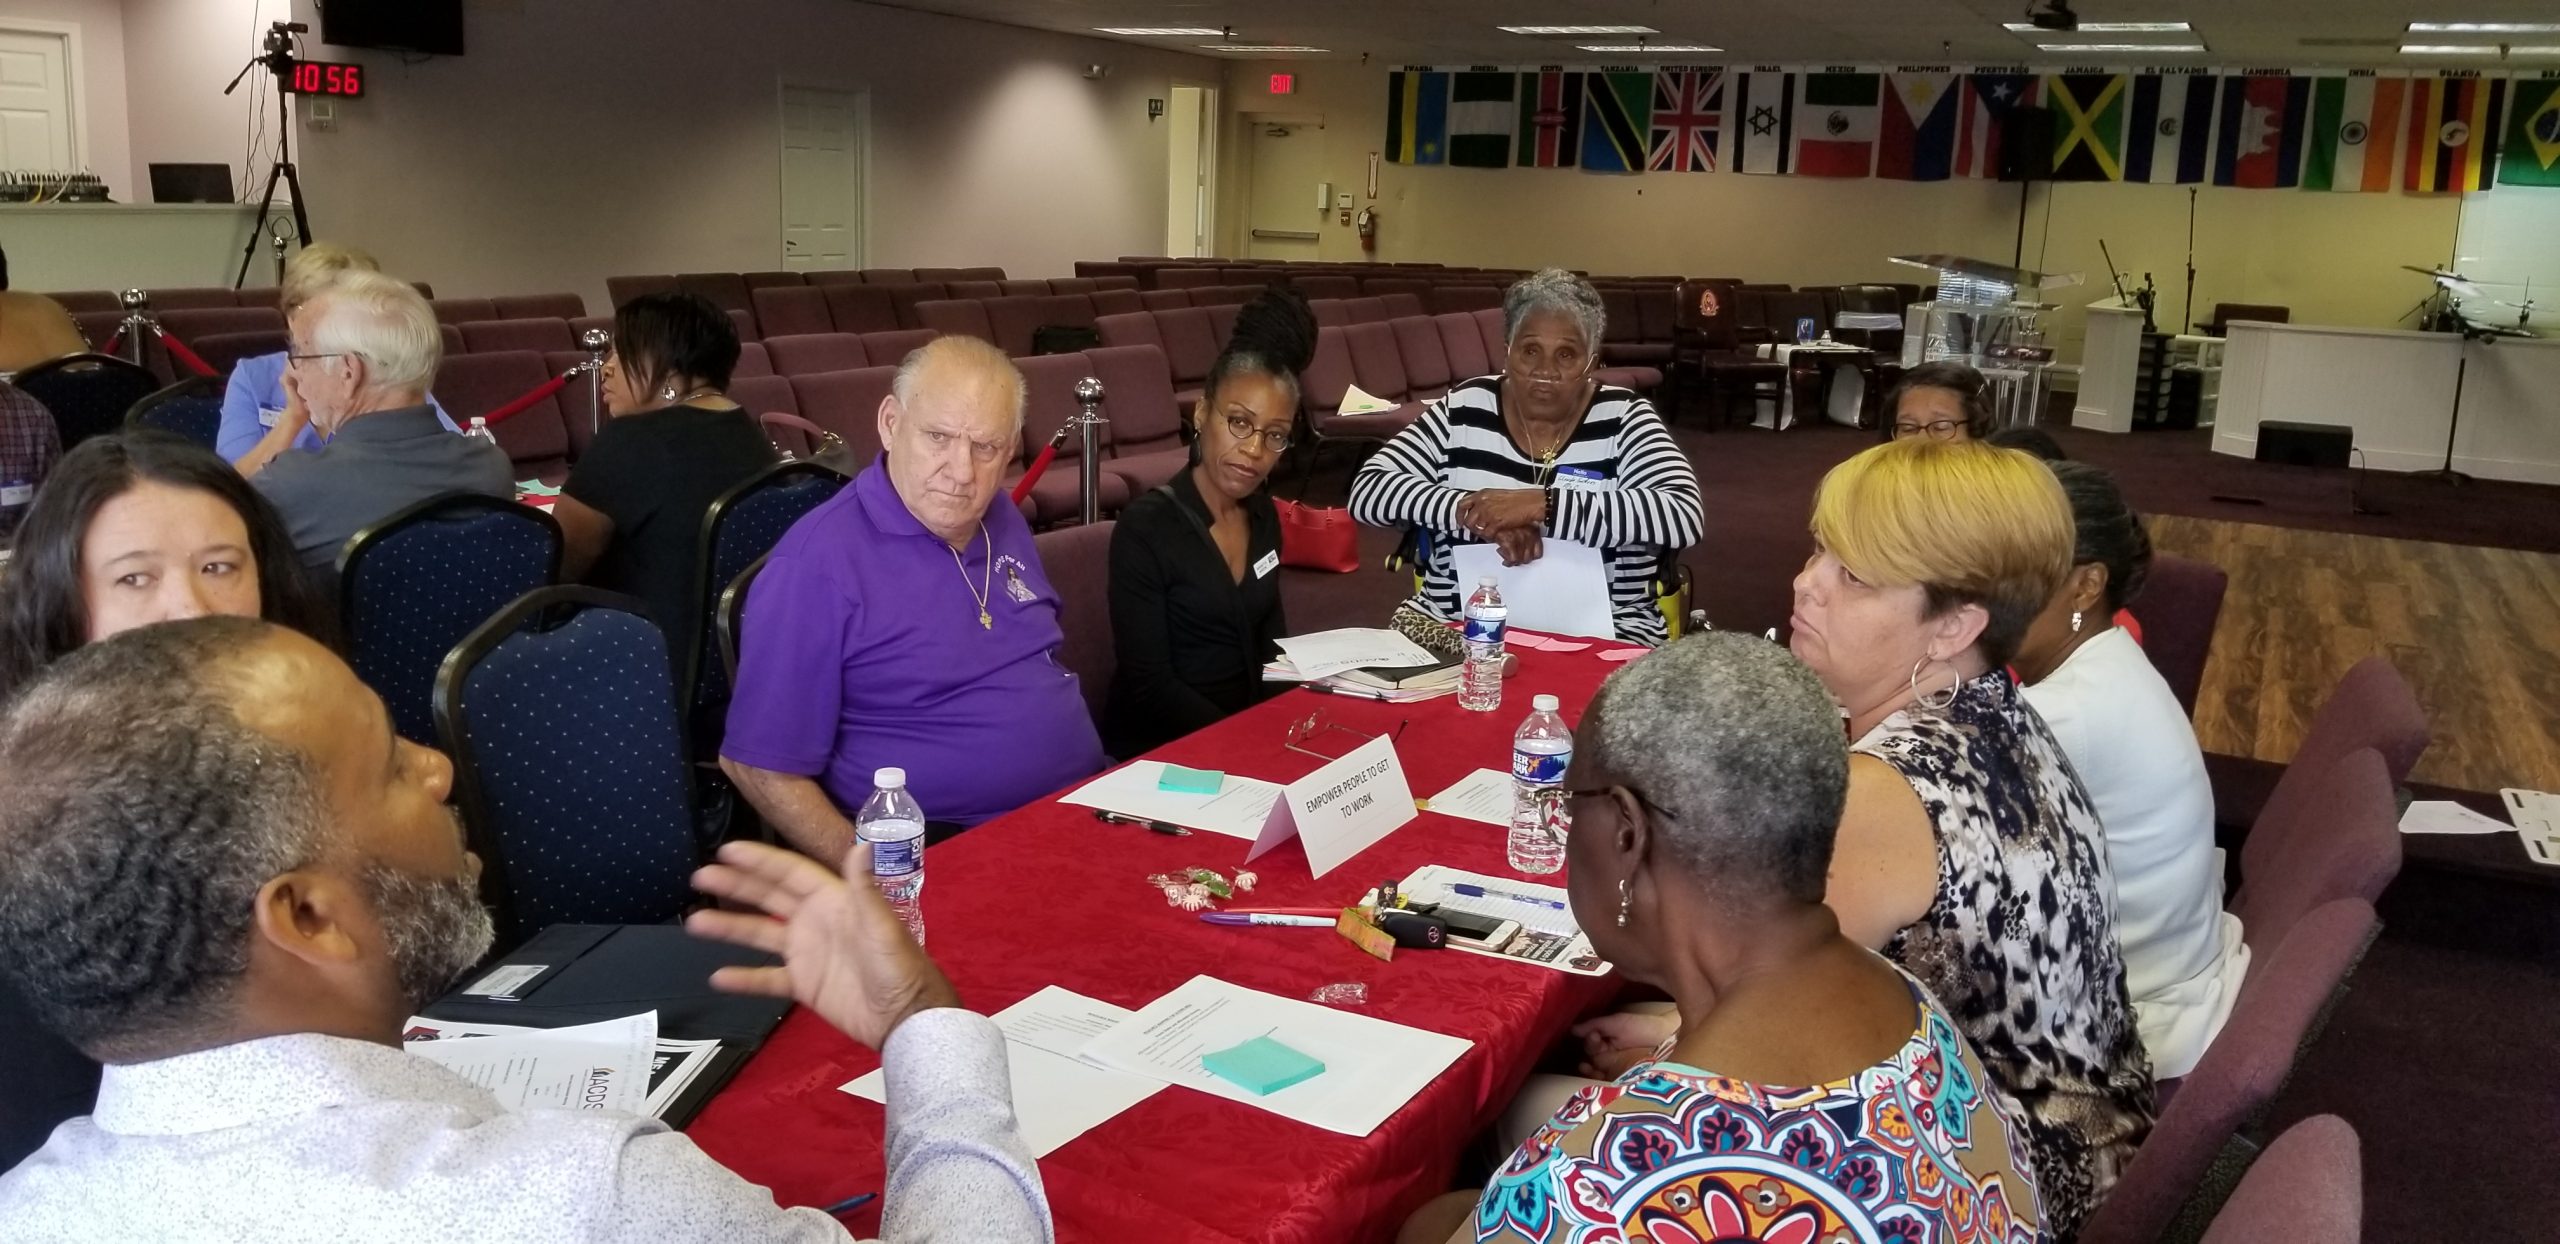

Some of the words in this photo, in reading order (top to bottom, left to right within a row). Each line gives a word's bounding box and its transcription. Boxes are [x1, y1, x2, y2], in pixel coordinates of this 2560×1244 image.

[1825, 65, 1856, 73] MEXICO
[1897, 65, 1951, 73] PHILIPPINES
[1974, 66, 2008, 74] PUERTO
[2064, 66, 2104, 74] JAMAICA
[2145, 66, 2156, 74] EL
[2159, 66, 2208, 74] SALVADOR
[2241, 68, 2291, 76] CAMBODIA
[2349, 68, 2376, 77] INDIA
[2440, 69, 2481, 77] UGANDA
[1271, 75, 1291, 94] EXIT
[1306, 784, 1344, 813] EMPOWER
[1342, 771, 1368, 793] PEOPLE
[1366, 765, 1377, 779] TO
[1376, 759, 1390, 774] GET
[1340, 805, 1352, 818] TO
[1351, 792, 1374, 812] WORK
